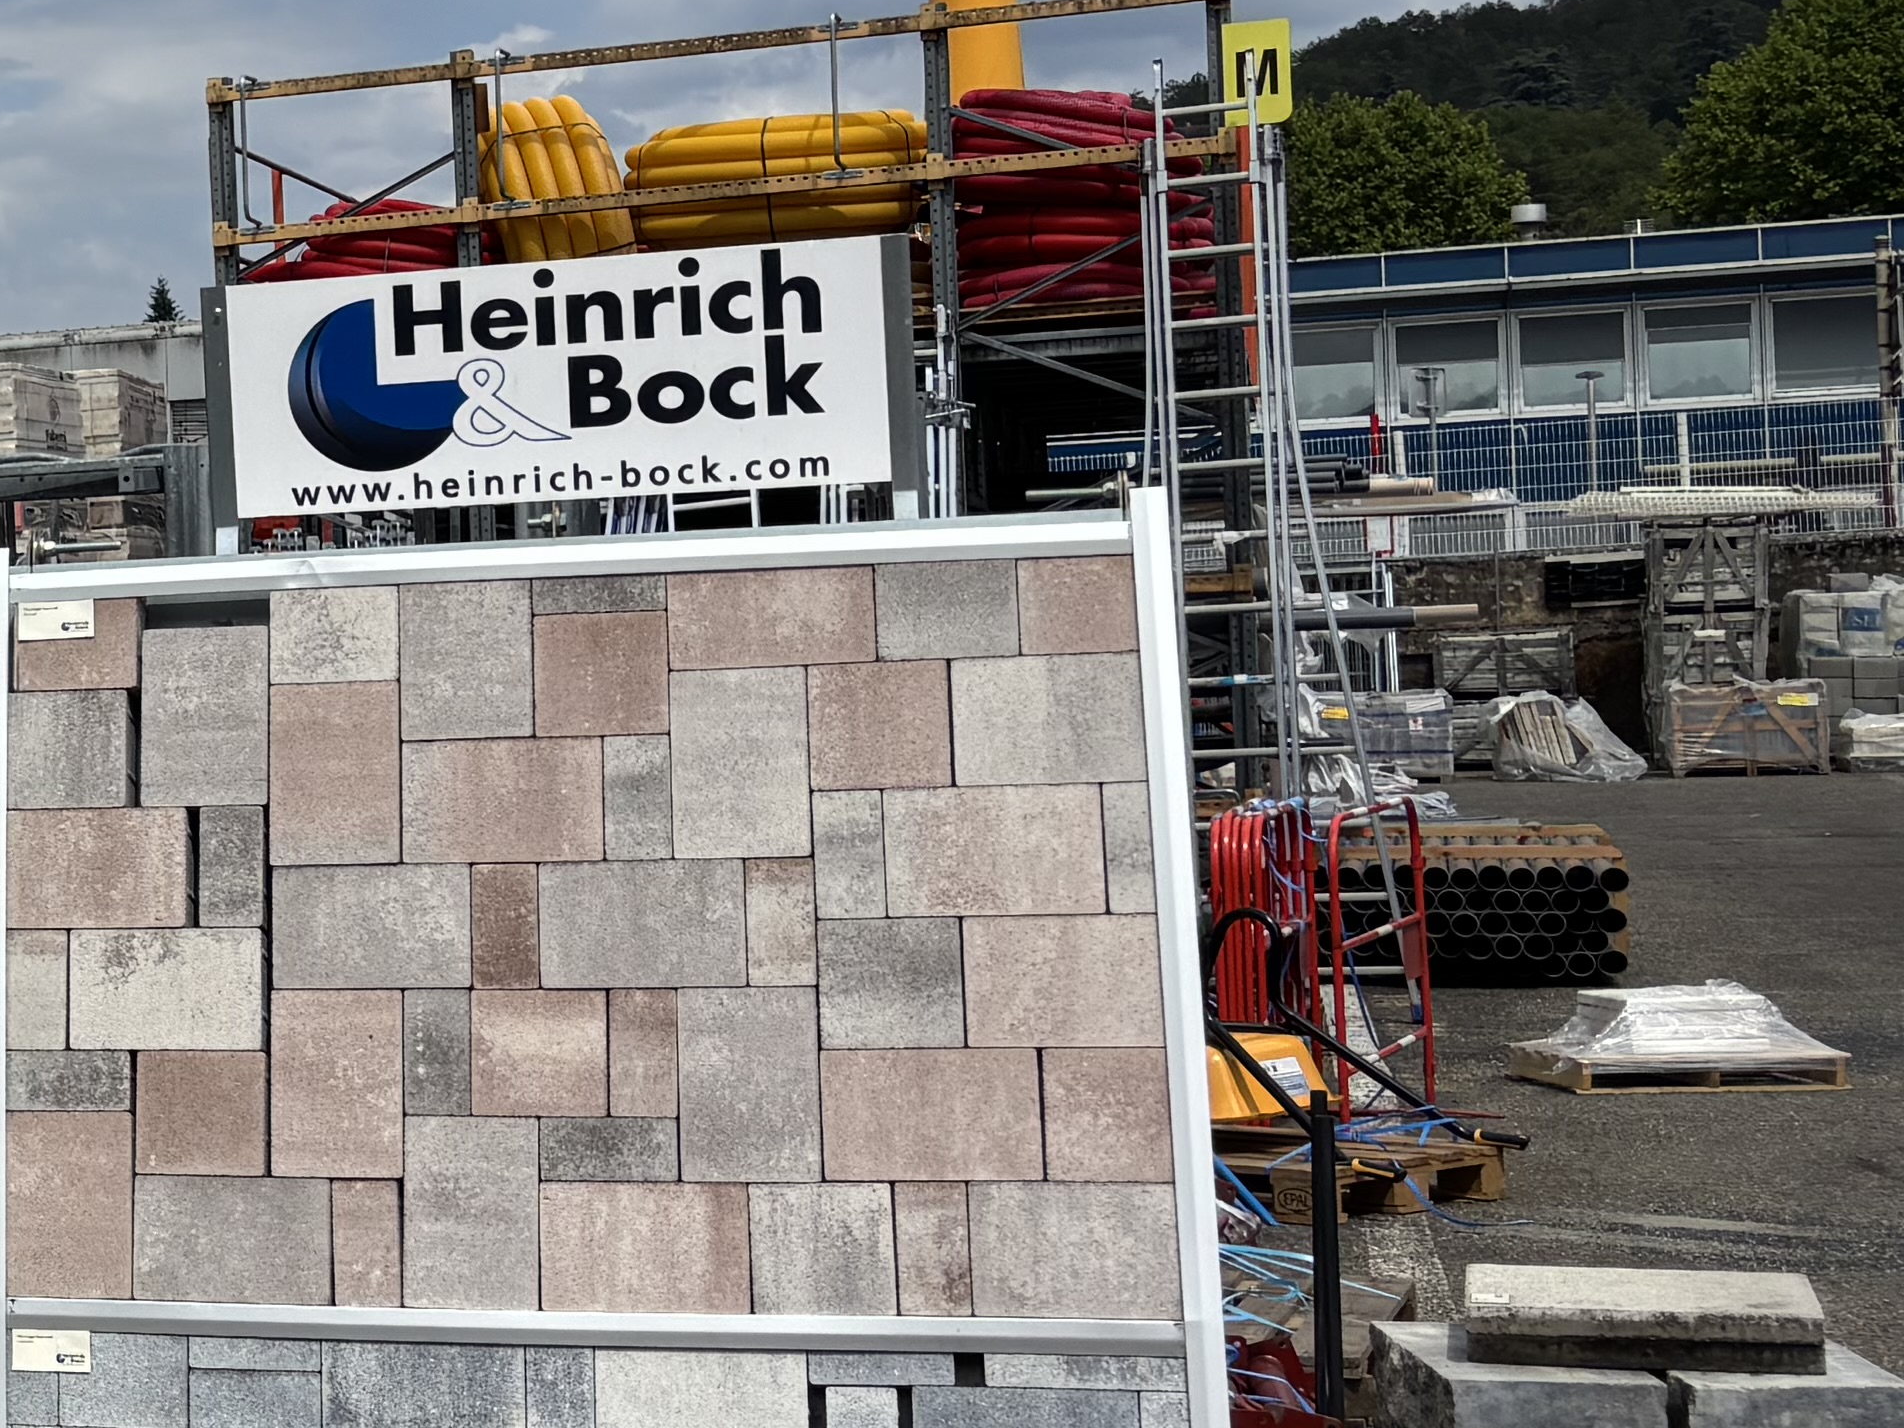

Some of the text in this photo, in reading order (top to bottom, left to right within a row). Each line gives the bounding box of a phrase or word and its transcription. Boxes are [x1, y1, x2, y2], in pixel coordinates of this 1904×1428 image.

[1235, 47, 1279, 98] M
[393, 248, 823, 357] Heinrich
[452, 334, 826, 447] & Bock
[292, 454, 831, 507] www.heinrich-bock.com
